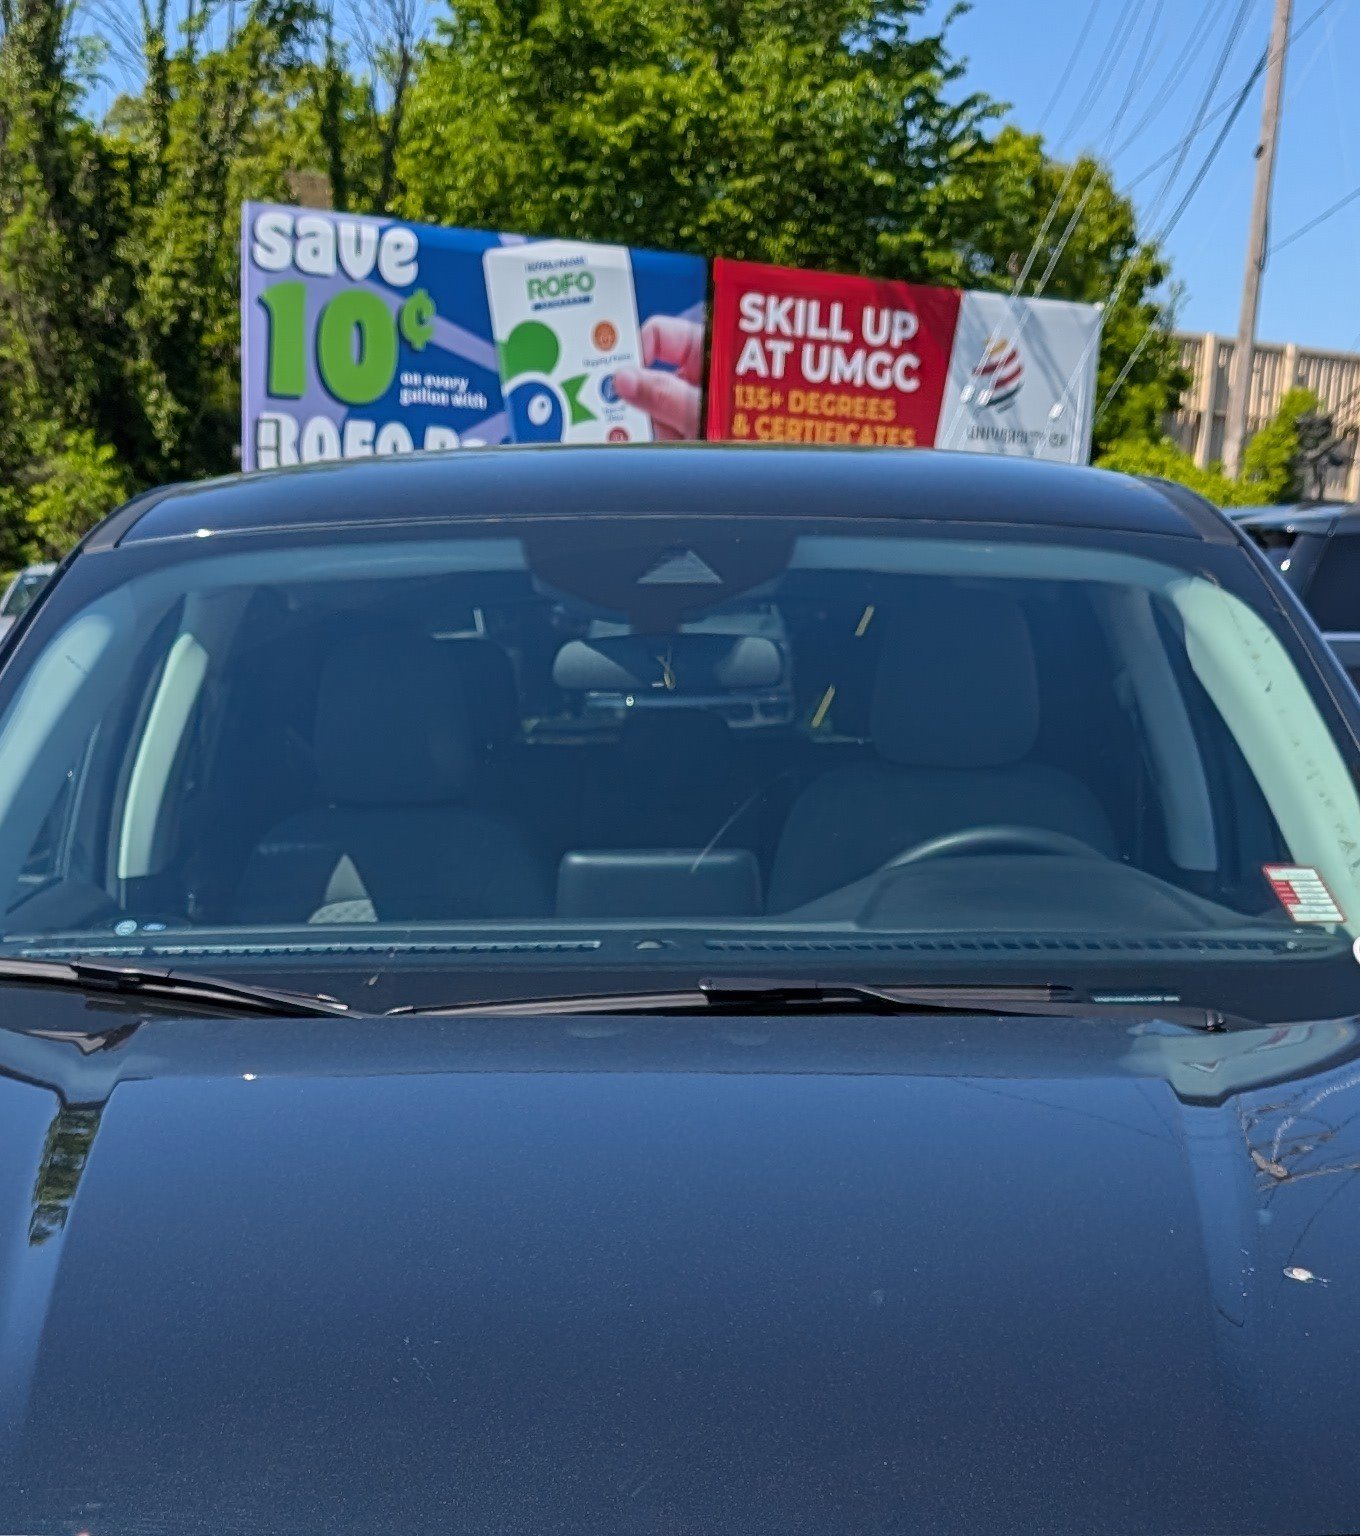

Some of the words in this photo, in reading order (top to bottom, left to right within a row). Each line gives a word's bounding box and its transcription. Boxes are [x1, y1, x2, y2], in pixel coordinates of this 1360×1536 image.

[253, 211, 419, 287] save
[739, 292, 853, 344] SKILL
[862, 305, 919, 349] UP
[735, 336, 795, 380] AT
[801, 342, 921, 393] UMGC
[400, 372, 422, 386] on
[424, 374, 469, 392] every
[400, 388, 449, 407] gallon
[451, 391, 487, 410] with
[788, 389, 897, 423] DEGREES
[754, 415, 916, 448] CERTIFICATES
